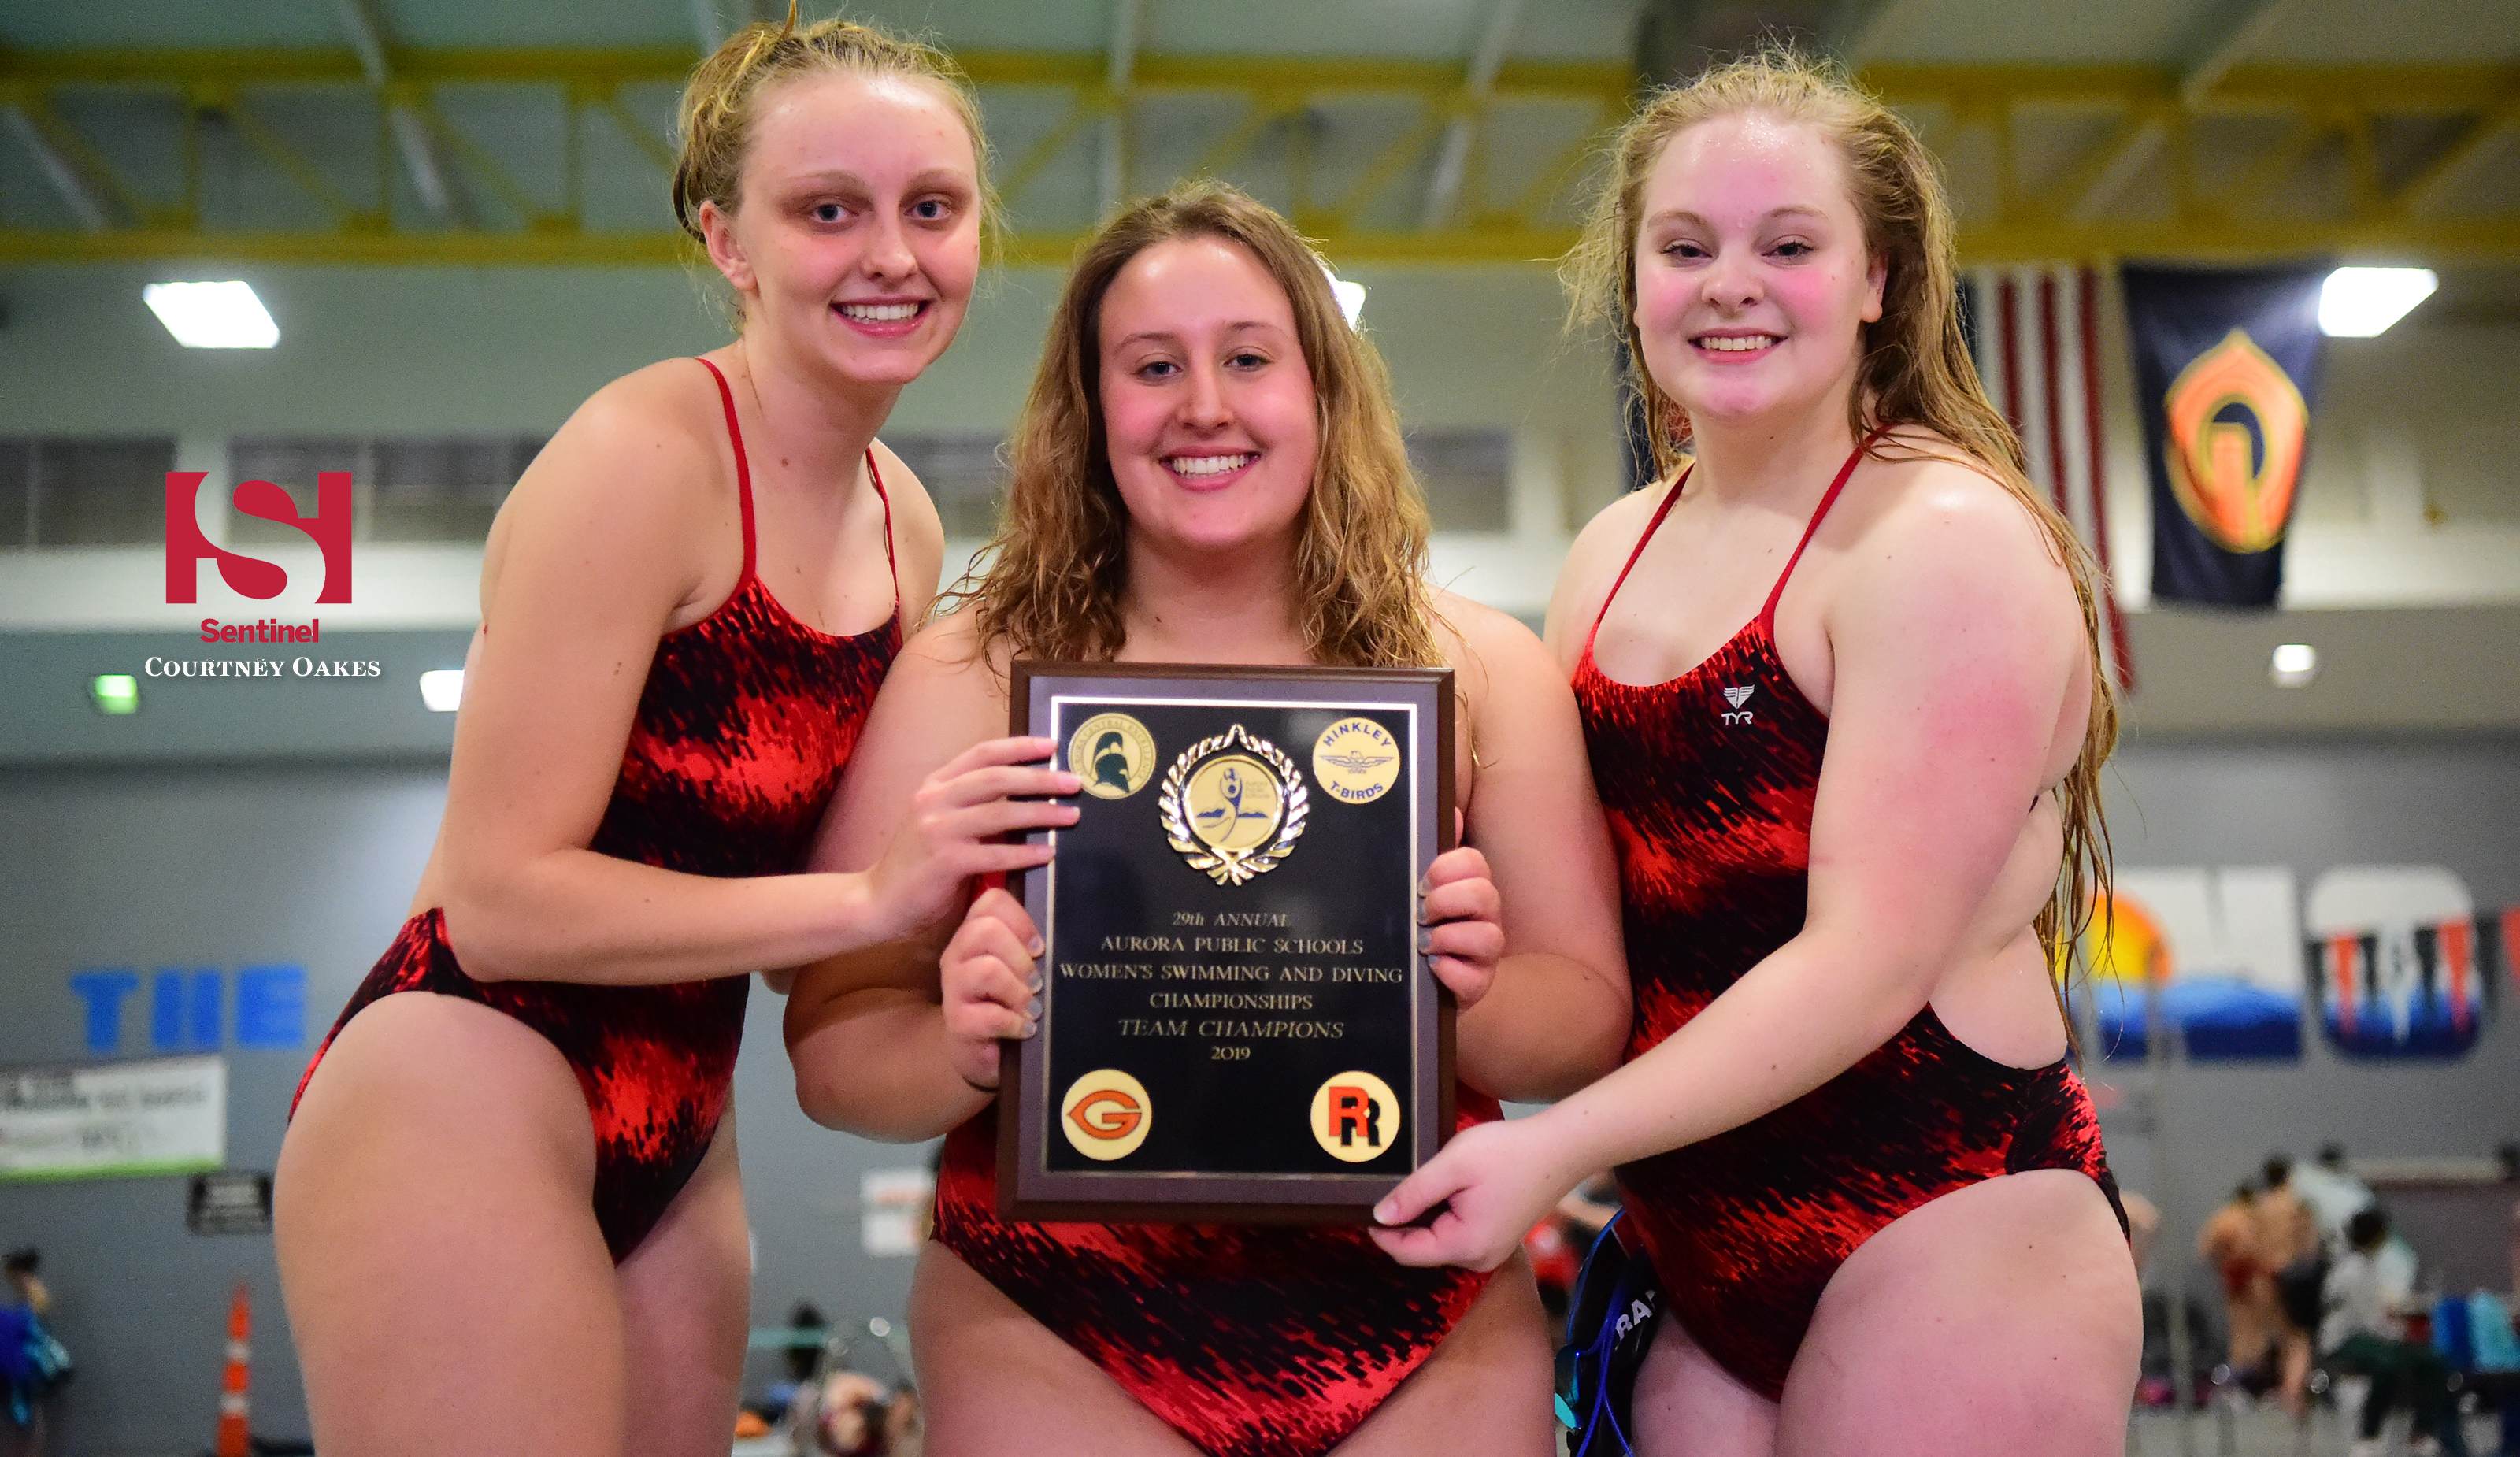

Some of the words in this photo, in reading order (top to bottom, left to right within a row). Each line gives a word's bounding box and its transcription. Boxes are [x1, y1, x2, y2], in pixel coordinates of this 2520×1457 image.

[1721, 711, 1754, 725] TYR
[1323, 722, 1392, 747] HINKLEY
[1330, 780, 1384, 799] T-BIRDS
[1173, 911, 1204, 926] 29th
[1214, 912, 1290, 927] ANNUAL
[1101, 935, 1184, 951] AURORA
[1195, 936, 1266, 953] PUBLIC
[1273, 938, 1363, 955] SCHOOLS
[1059, 963, 1154, 979] WOMEN'S
[1161, 964, 1269, 981] SWIMMING
[1280, 966, 1323, 982] AND
[1332, 967, 1403, 983] DIVING
[70, 965, 306, 1049] THE
[1149, 992, 1313, 1010] CHAMPIONSHIPS
[1118, 1019, 1188, 1036] TEAM
[1199, 1020, 1344, 1038] CHAMPIONS
[1211, 1046, 1251, 1060] 2019
[1068, 1089, 1142, 1140] G
